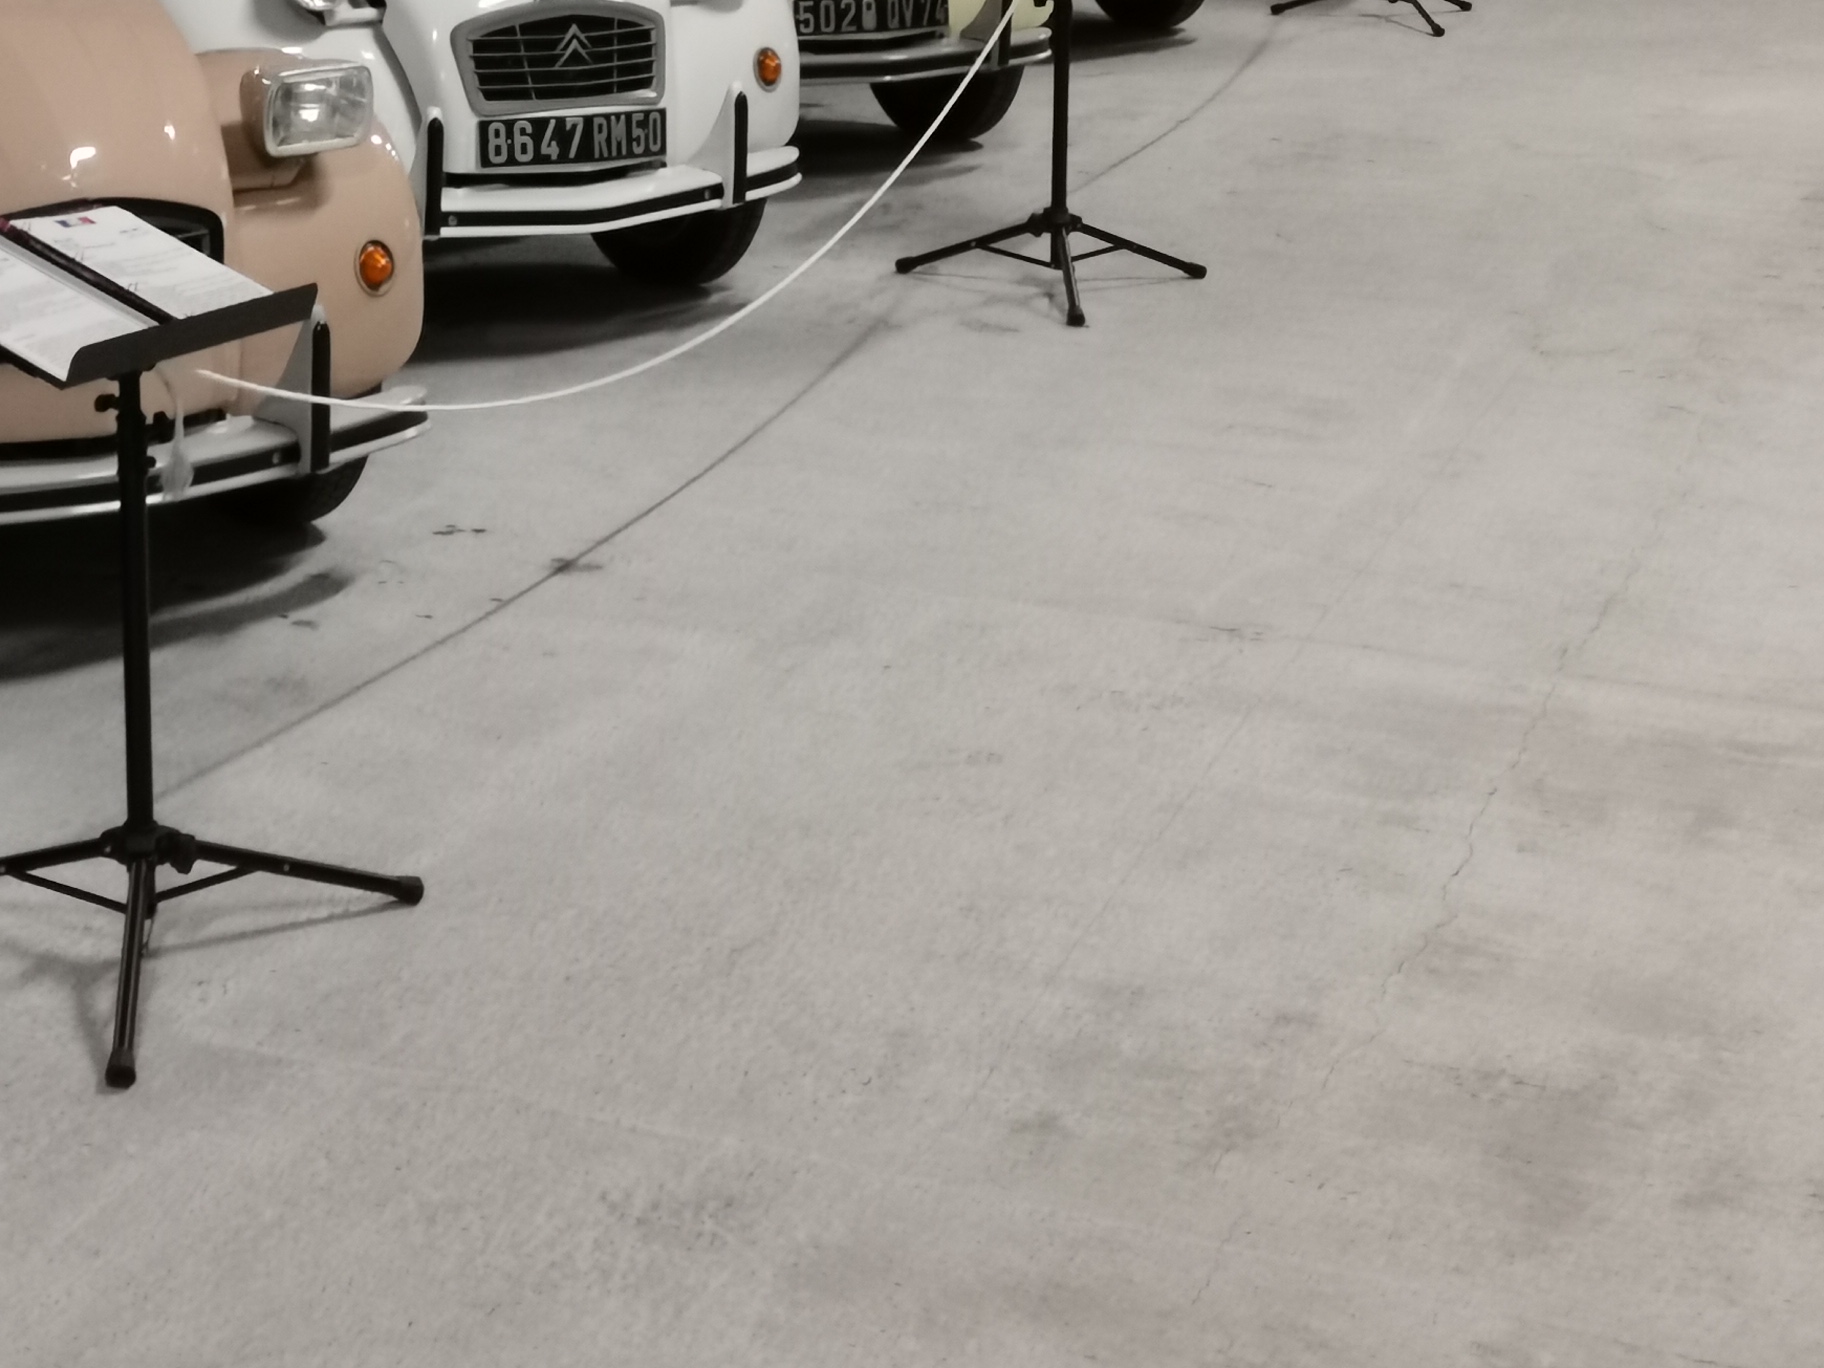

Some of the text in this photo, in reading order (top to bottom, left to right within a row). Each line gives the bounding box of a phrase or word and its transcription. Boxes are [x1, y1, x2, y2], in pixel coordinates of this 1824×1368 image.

[487, 111, 661, 164] 8647 RM 50
